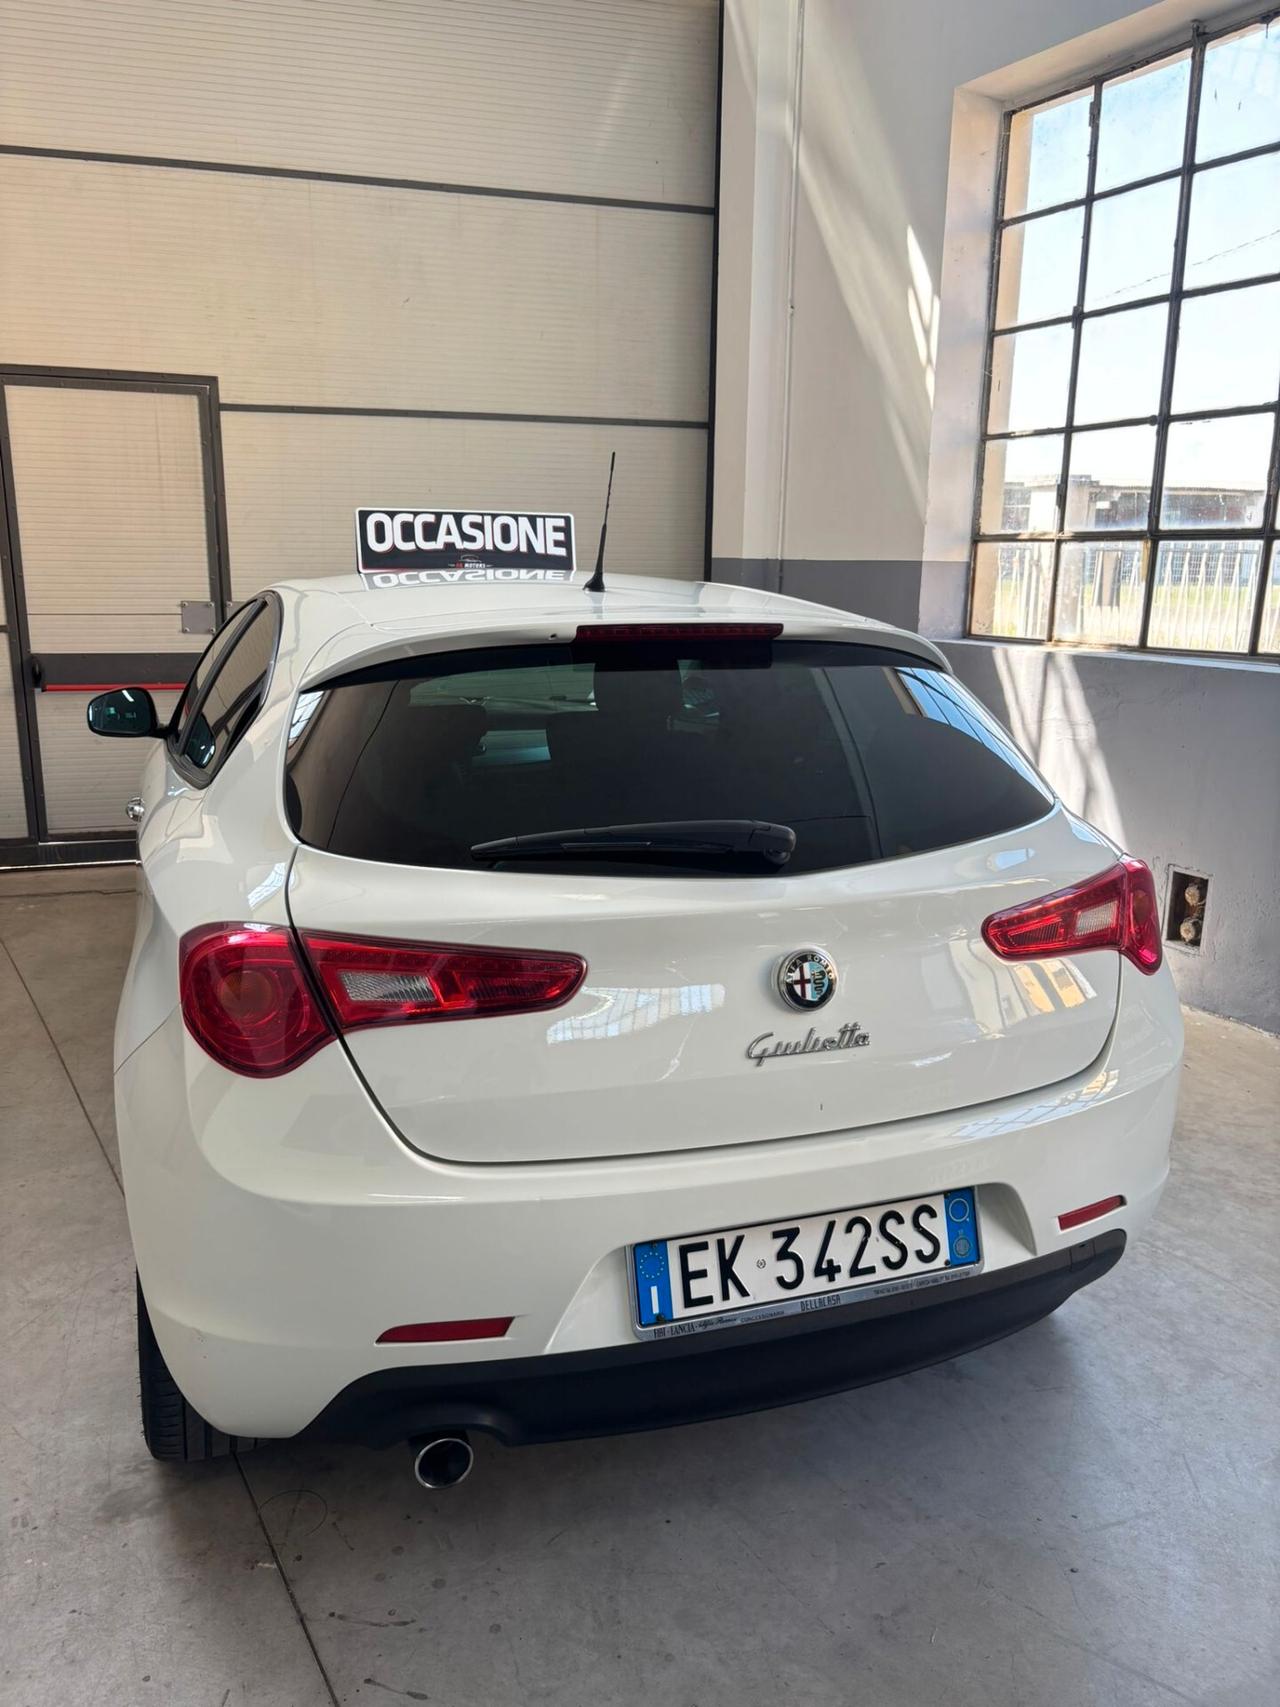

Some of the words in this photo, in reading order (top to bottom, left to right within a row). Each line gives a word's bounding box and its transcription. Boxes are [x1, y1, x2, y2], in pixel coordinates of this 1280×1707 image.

[366, 512, 567, 557] OCCASIONE
[746, 1022, 870, 1067] Giulietta
[678, 1234, 751, 1309] EK
[772, 1203, 941, 1291] 342SS
